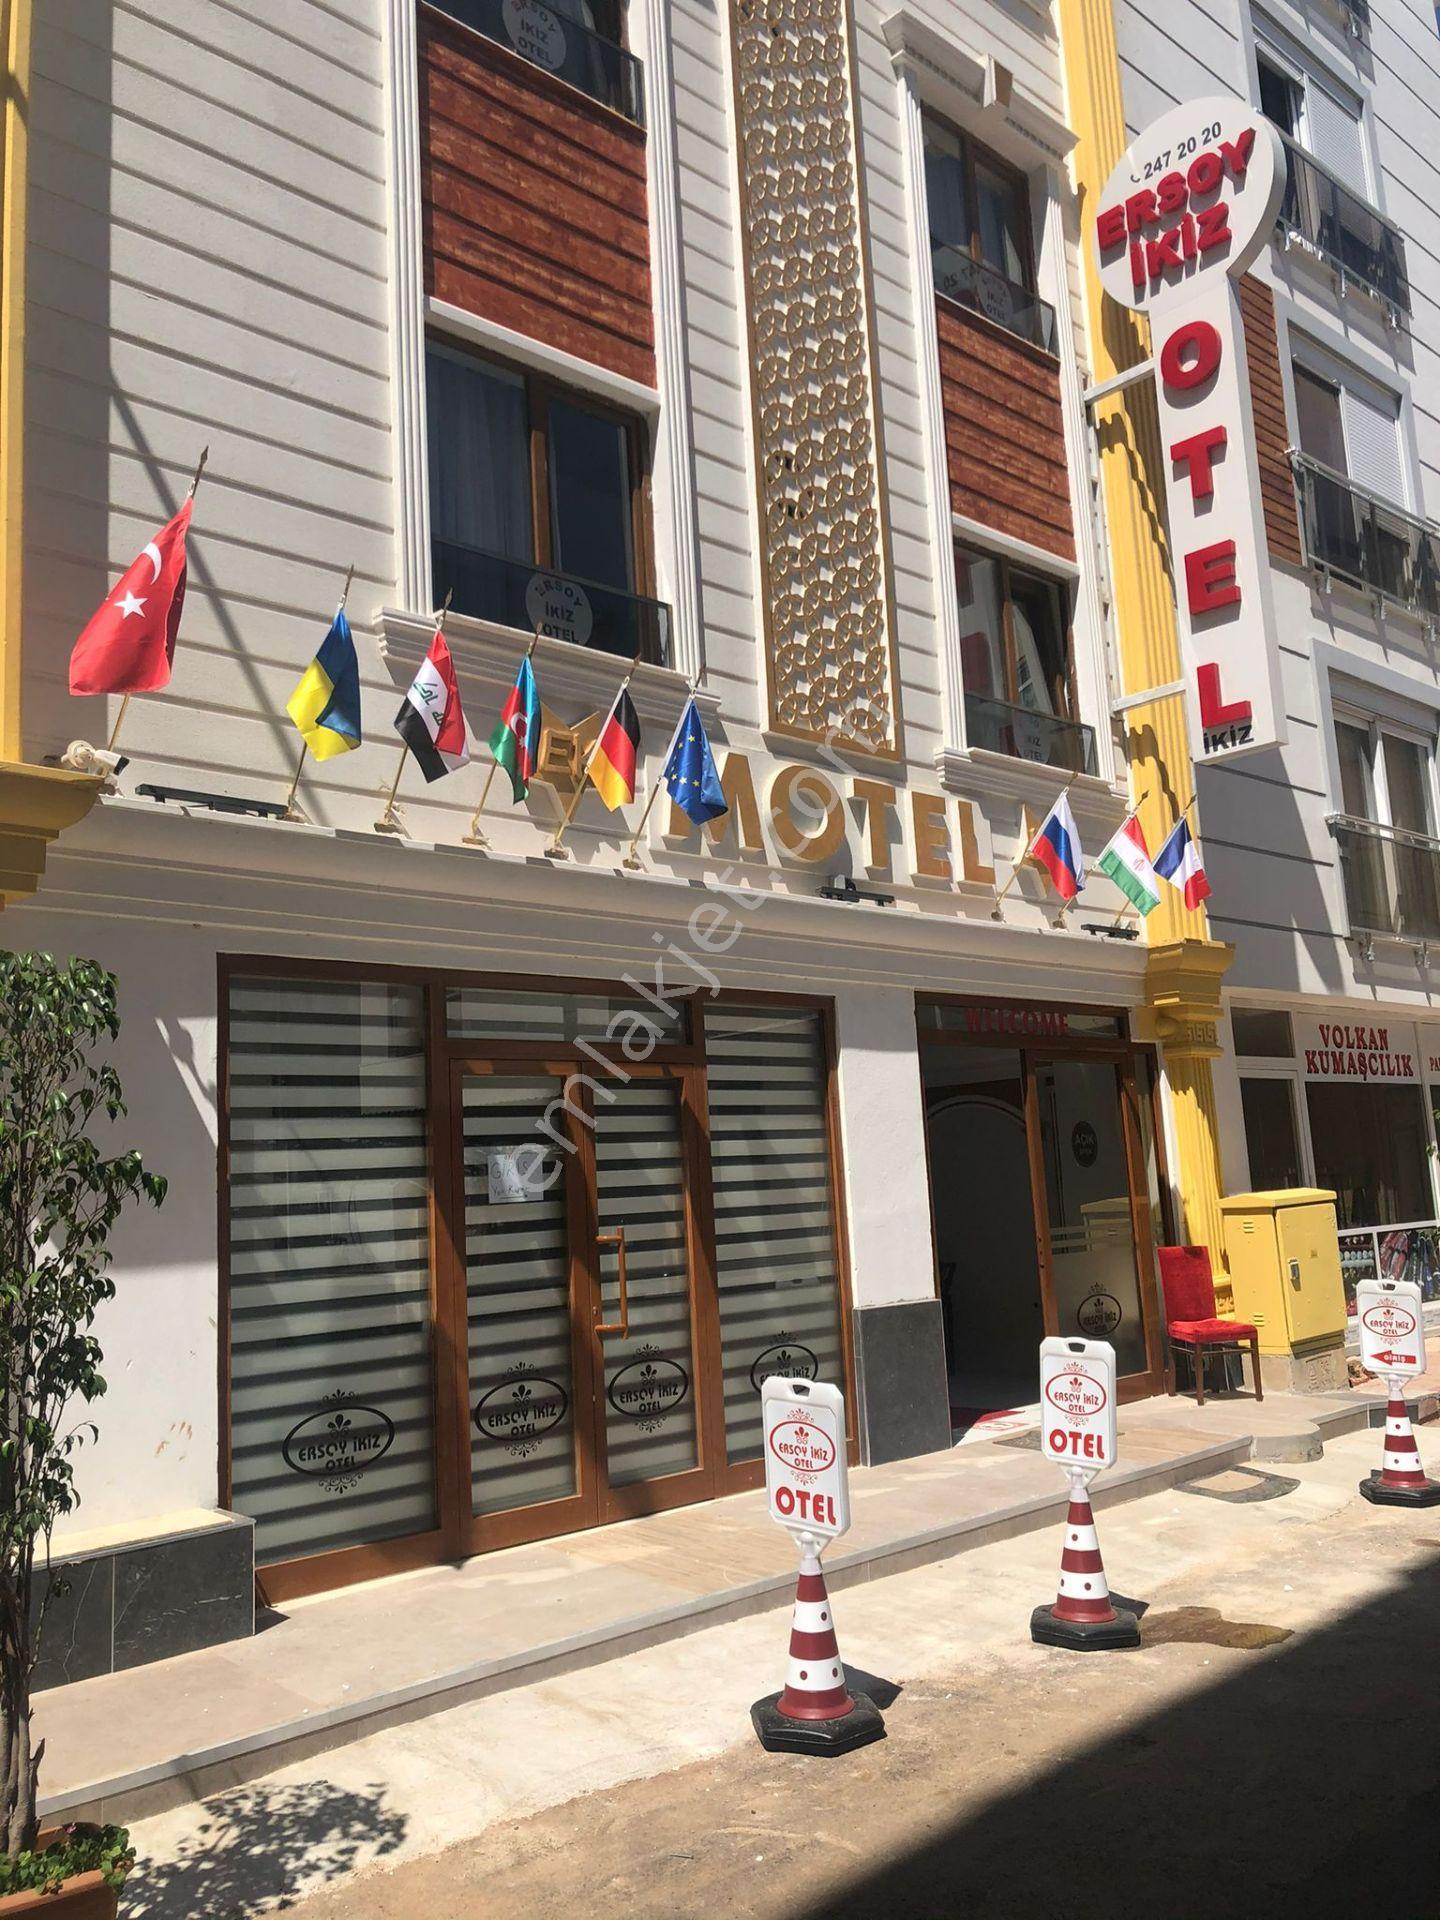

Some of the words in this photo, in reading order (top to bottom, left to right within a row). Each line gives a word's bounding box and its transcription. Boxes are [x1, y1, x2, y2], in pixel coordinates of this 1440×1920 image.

[1143, 150, 1171, 180] 247
[1177, 136, 1197, 160] 20
[1201, 121, 1222, 146] 20
[1096, 126, 1257, 251] ERSOY
[1160, 320, 1252, 728] OTEL
[1203, 724, 1255, 754] İKİZ
[1319, 1024, 1388, 1051] VOLKAN
[1370, 1320, 1393, 1329] ERSOY
[620, 1387, 655, 1404] ERSOY
[638, 1400, 661, 1413] OTEL
[1054, 1392, 1081, 1403] ERSOY
[1083, 1393, 1100, 1406] İKİZ
[487, 1409, 529, 1428] ERSOY
[533, 1403, 557, 1420] İKİZ
[1068, 1404, 1086, 1413] OTEL
[511, 1422, 537, 1437] OTEL
[298, 1440, 348, 1462] ERSOY
[353, 1434, 381, 1453] İKİZ
[778, 1442, 808, 1457] ERSOY
[810, 1446, 829, 1461] İKİZ
[1049, 1428, 1105, 1460] OTEL
[325, 1455, 357, 1472] OTEL
[794, 1458, 814, 1469] OTEL
[775, 1486, 837, 1526] OTEL
